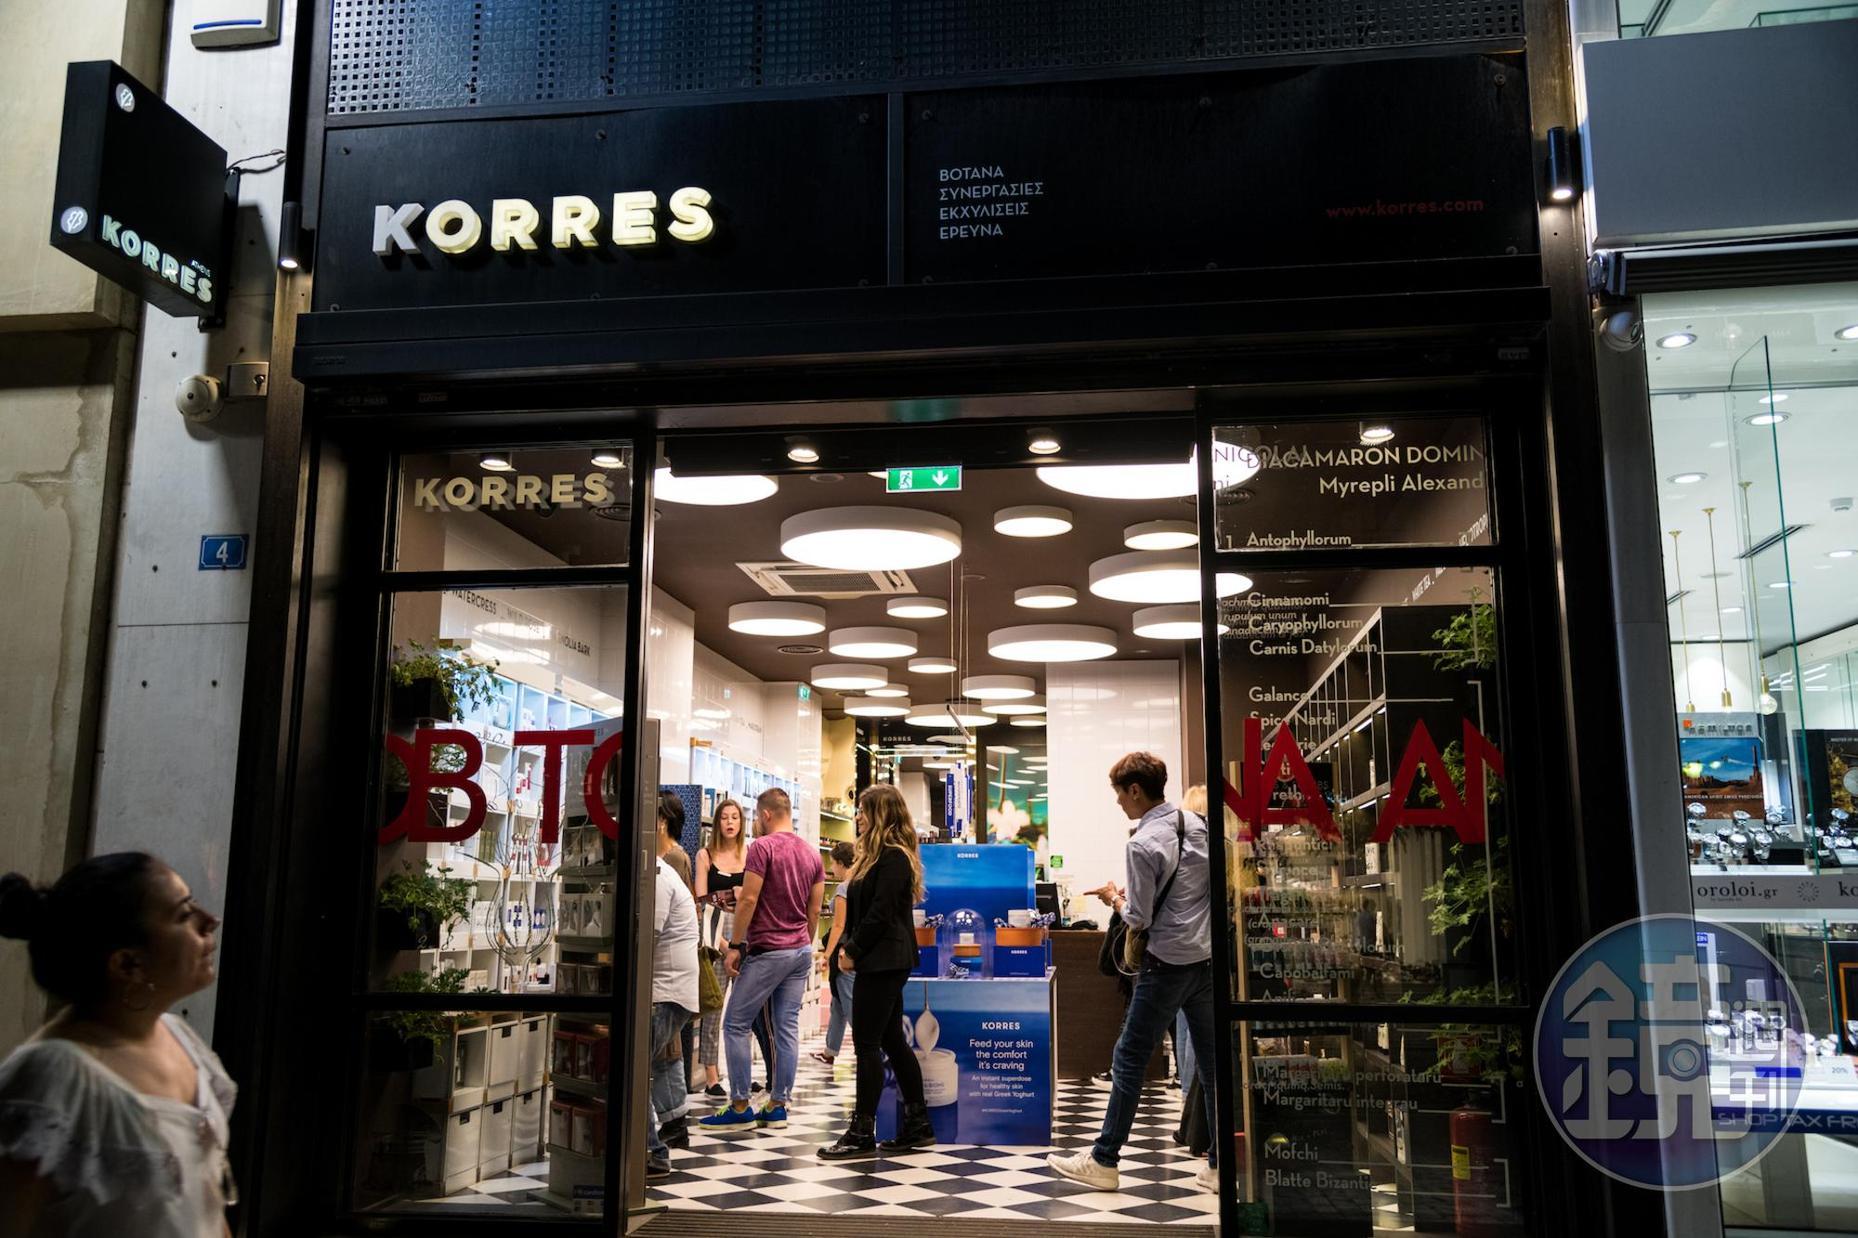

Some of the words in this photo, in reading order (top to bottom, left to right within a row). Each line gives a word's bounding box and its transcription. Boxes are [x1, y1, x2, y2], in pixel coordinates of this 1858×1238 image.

[940, 166, 1004, 181] ΒΟΤΑΝΑ
[940, 182, 1044, 200] ΣΥΝΕΡΓΑΣΙΕΣ
[940, 202, 1029, 220] ΕΚΧΥΛΙΣΕΙΣ
[1326, 198, 1484, 218] www.korres.com
[373, 187, 714, 257] KORRES
[940, 224, 1004, 239] ΕΡΕΥΝΑ
[102, 214, 212, 302] KORRES
[415, 472, 608, 507] KORRES
[1247, 530, 1351, 550] Antophyllorum
[216, 541, 228, 563] 4
[1249, 592, 1329, 608] Cinnamomi
[1250, 640, 1297, 656] Carnis
[1295, 709, 1336, 726] Nardi
[1697, 881, 1778, 899] oroloi.gr
[981, 1021, 1021, 1030] KORRES
[969, 1038, 992, 1048] Feed
[994, 1040, 1014, 1050] your
[1016, 1039, 1034, 1048] skin
[976, 1050, 991, 1058] the
[992, 1050, 1027, 1058] comfort
[978, 1060, 990, 1069] it's
[992, 1061, 1025, 1071] craving
[1013, 1091, 1035, 1099] Yoghurt
[1827, 1115, 1858, 1129] FR
[1264, 1169, 1312, 1188] Blatte
